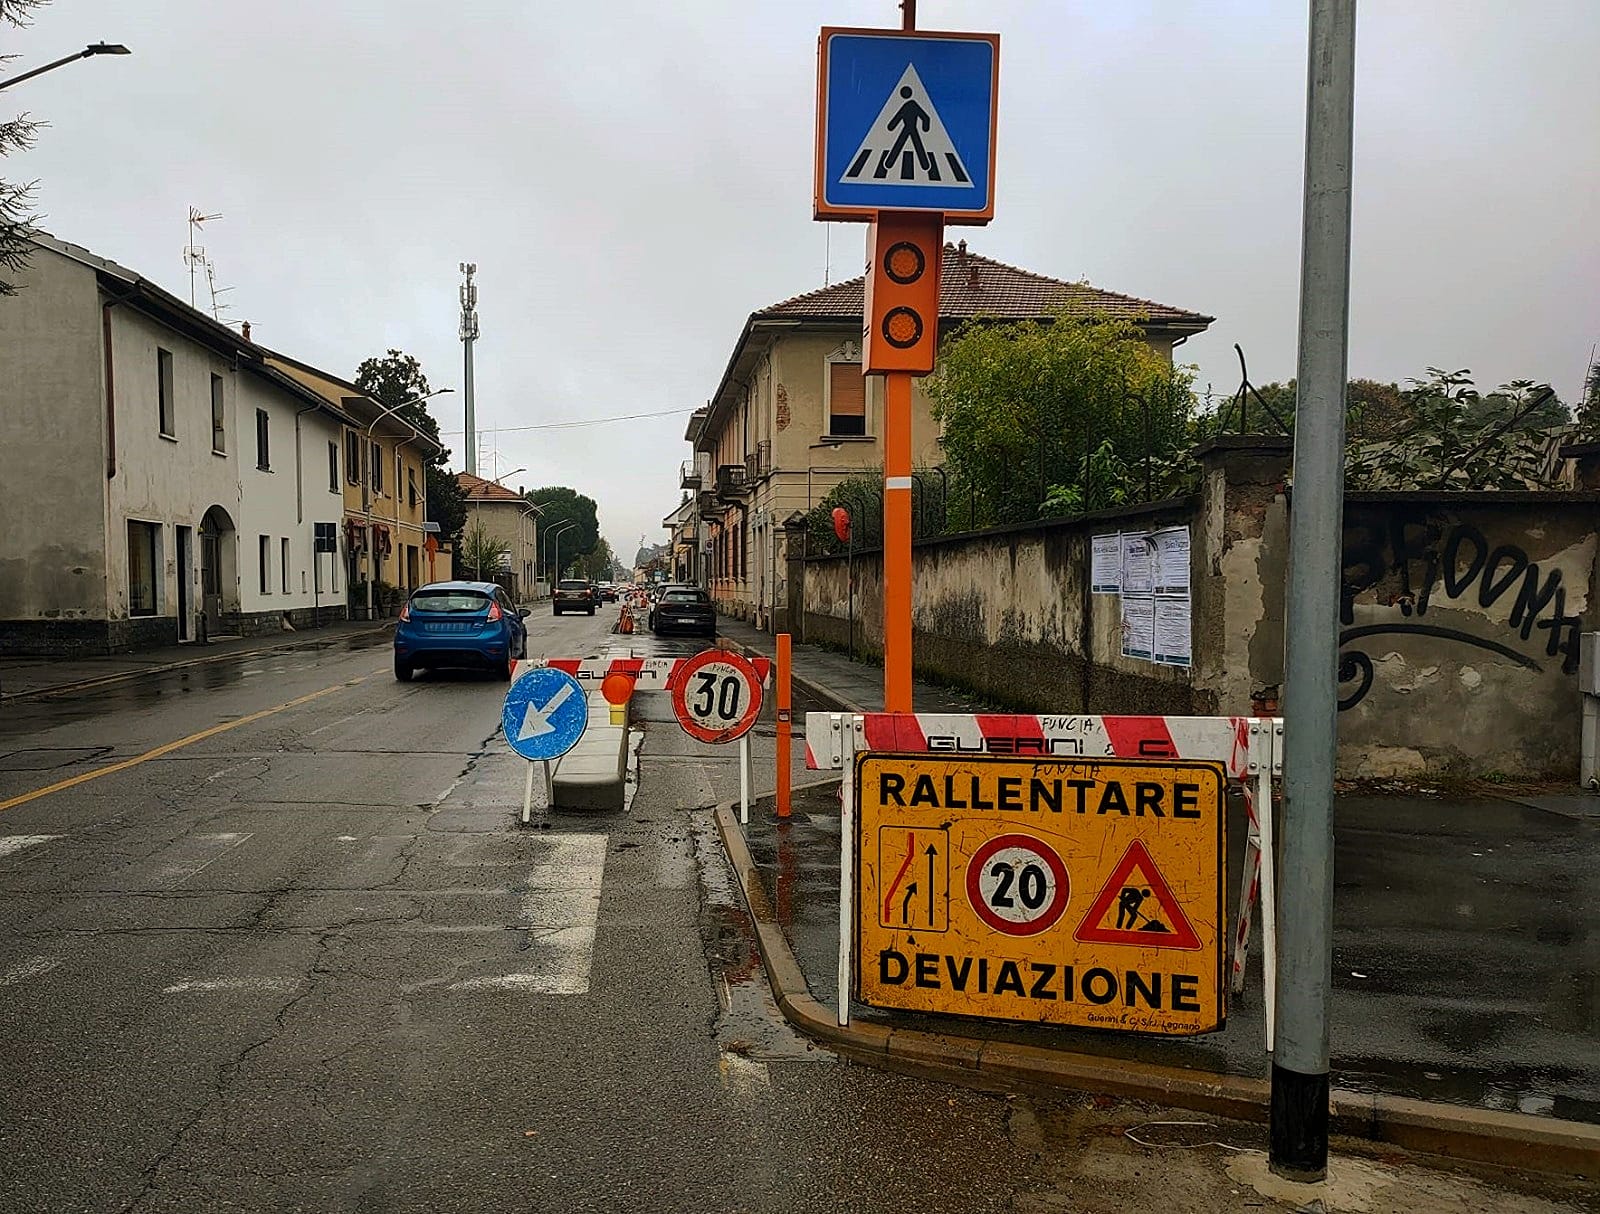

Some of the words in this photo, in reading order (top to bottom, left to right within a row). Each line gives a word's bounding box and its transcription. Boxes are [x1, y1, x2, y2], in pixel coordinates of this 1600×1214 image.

[693, 671, 741, 721] 30
[927, 736, 1085, 754] GUERINI
[879, 772, 1201, 819] RALLENTARE
[989, 862, 1048, 910] 20
[879, 950, 1201, 1012] DEVIAZIONE
